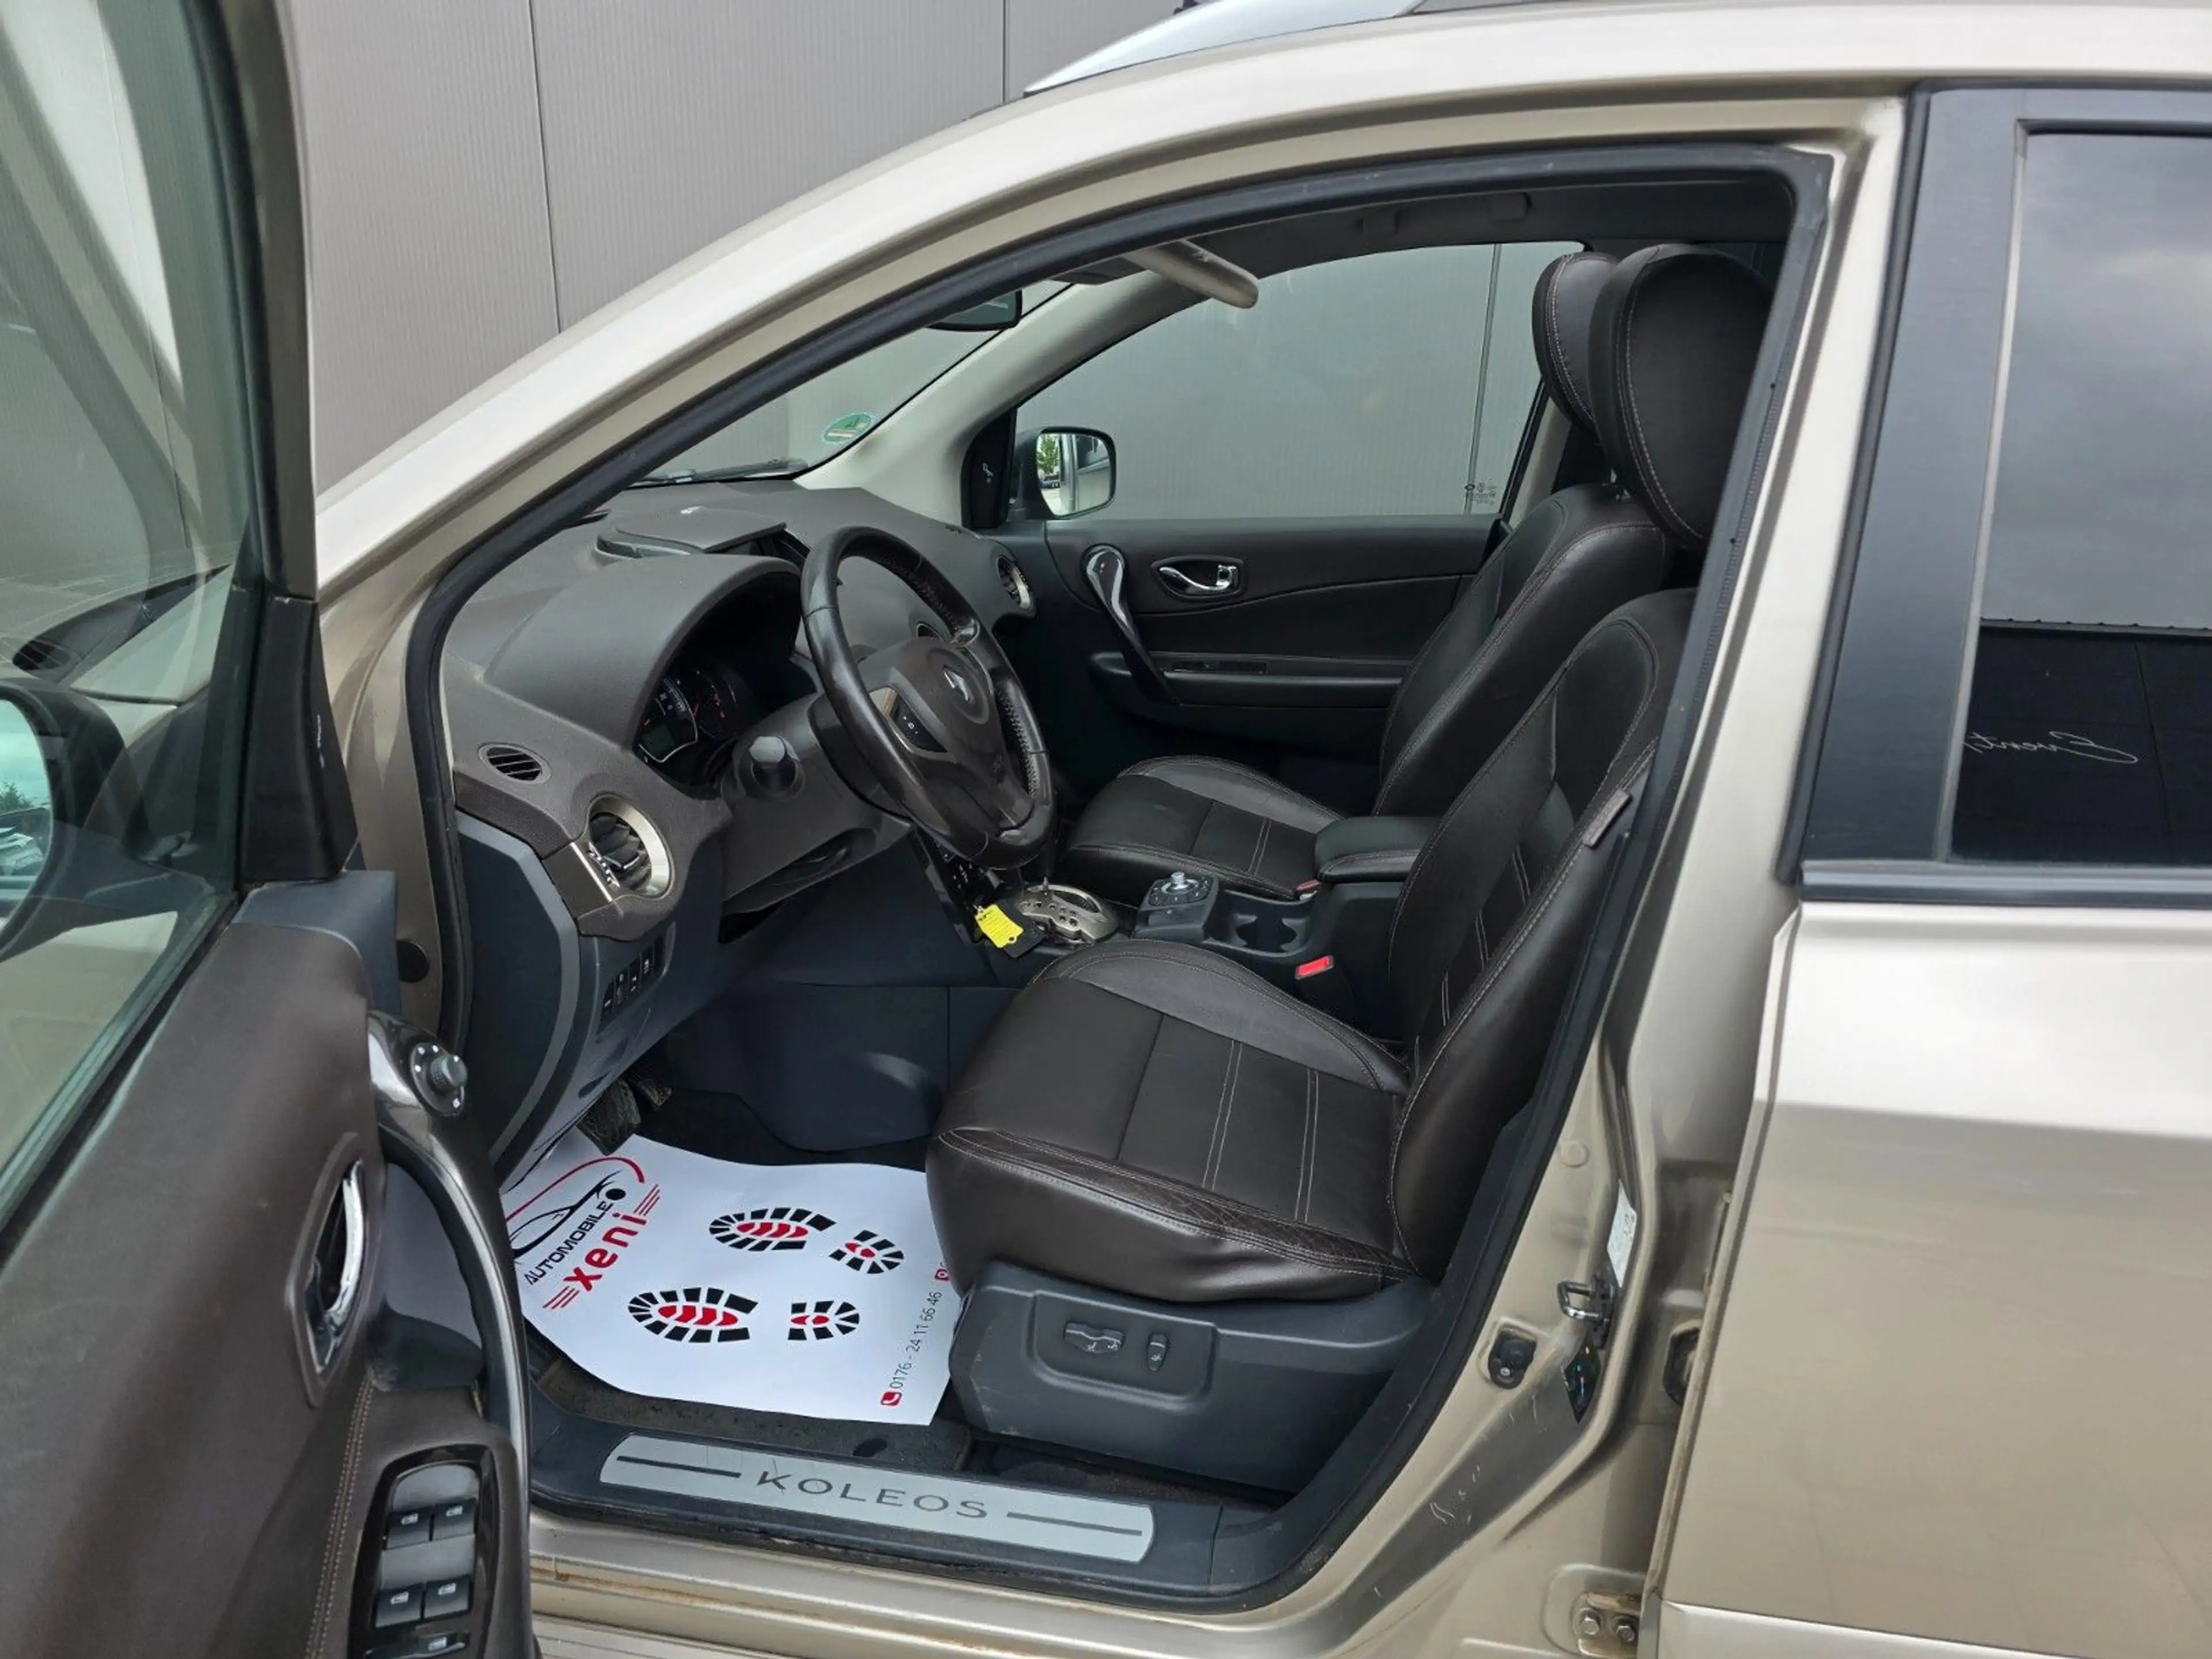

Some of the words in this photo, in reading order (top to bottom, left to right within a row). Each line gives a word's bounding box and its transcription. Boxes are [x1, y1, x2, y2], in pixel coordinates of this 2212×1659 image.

[524, 1200, 614, 1285] AUTOMOBILE
[563, 1212, 647, 1291] xeni
[927, 1291, 942, 1306] 46
[920, 1308, 935, 1321] 66
[914, 1324, 929, 1335] 11
[906, 1339, 921, 1353] 24
[889, 1362, 912, 1388] 0176
[756, 1470, 988, 1519] KOLEOS
